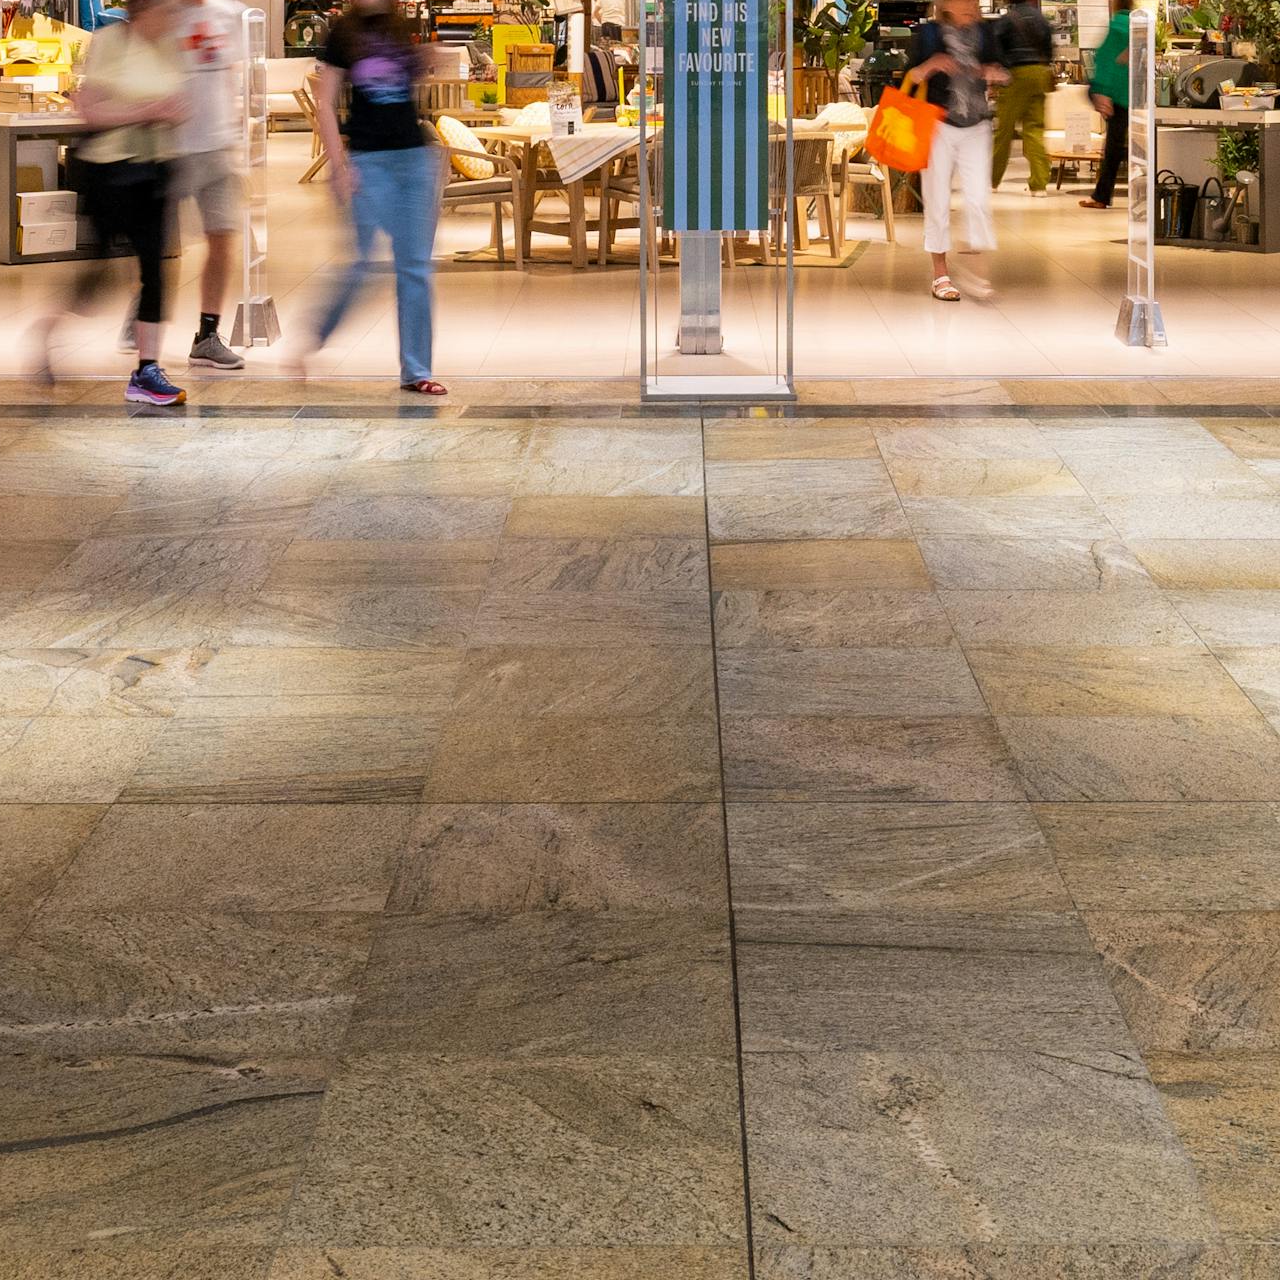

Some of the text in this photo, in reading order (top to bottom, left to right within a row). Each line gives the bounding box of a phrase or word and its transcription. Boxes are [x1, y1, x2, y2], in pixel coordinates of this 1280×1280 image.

[685, 2, 747, 22] FIND HIS
[702, 27, 732, 47] NEW
[679, 53, 755, 73] FAVOURITE
